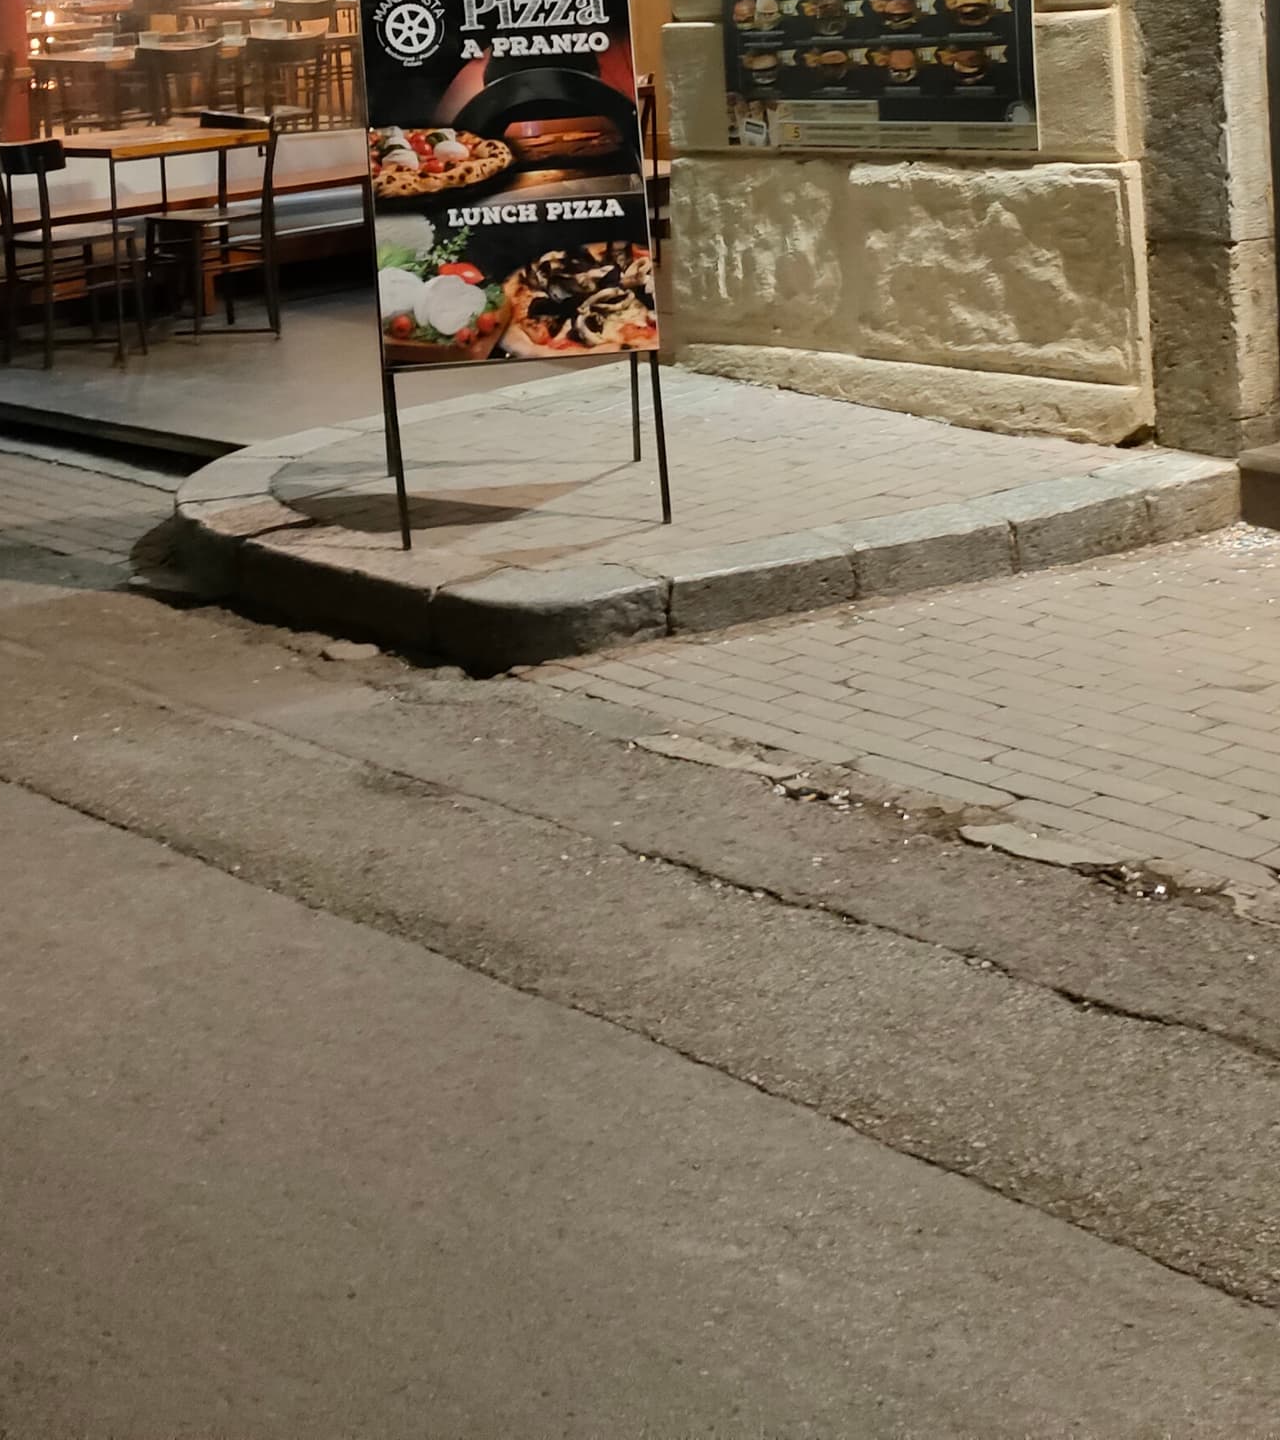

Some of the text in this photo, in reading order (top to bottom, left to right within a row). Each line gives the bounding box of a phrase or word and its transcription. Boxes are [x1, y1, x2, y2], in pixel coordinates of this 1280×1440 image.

[461, 39, 484, 59] A
[492, 32, 610, 58] PRANZO
[447, 199, 624, 227] LUNCH PIZZA
